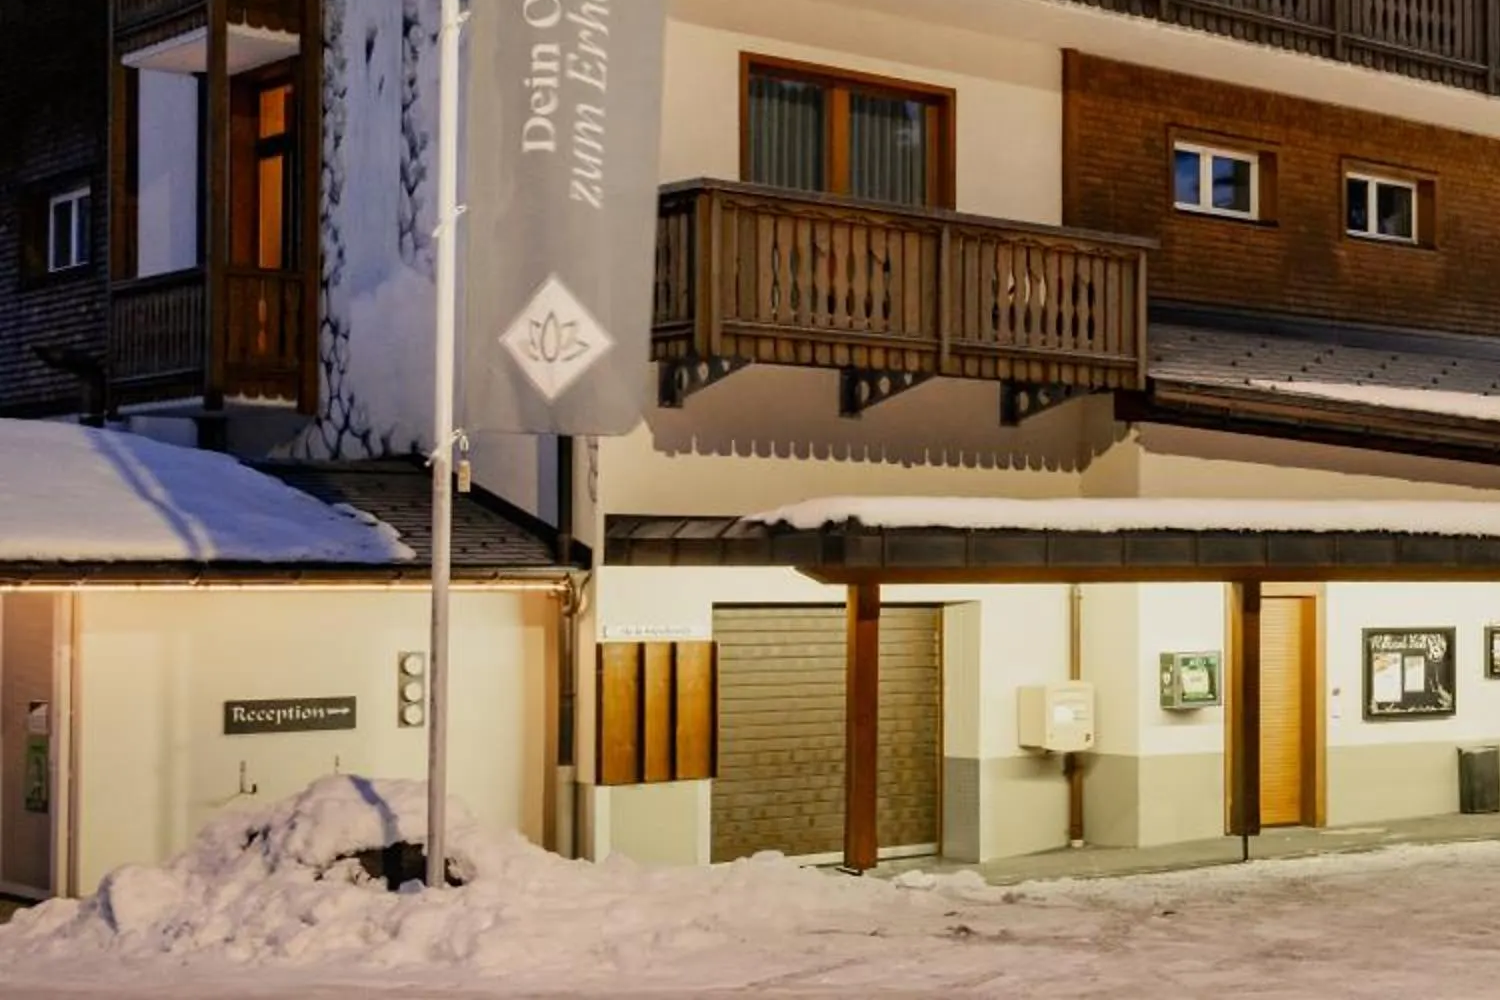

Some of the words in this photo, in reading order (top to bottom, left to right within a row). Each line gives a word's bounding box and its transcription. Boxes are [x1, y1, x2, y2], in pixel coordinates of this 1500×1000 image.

[522, 43, 561, 152] Dein
[568, 102, 606, 209] zum
[231, 705, 326, 724] Reception
